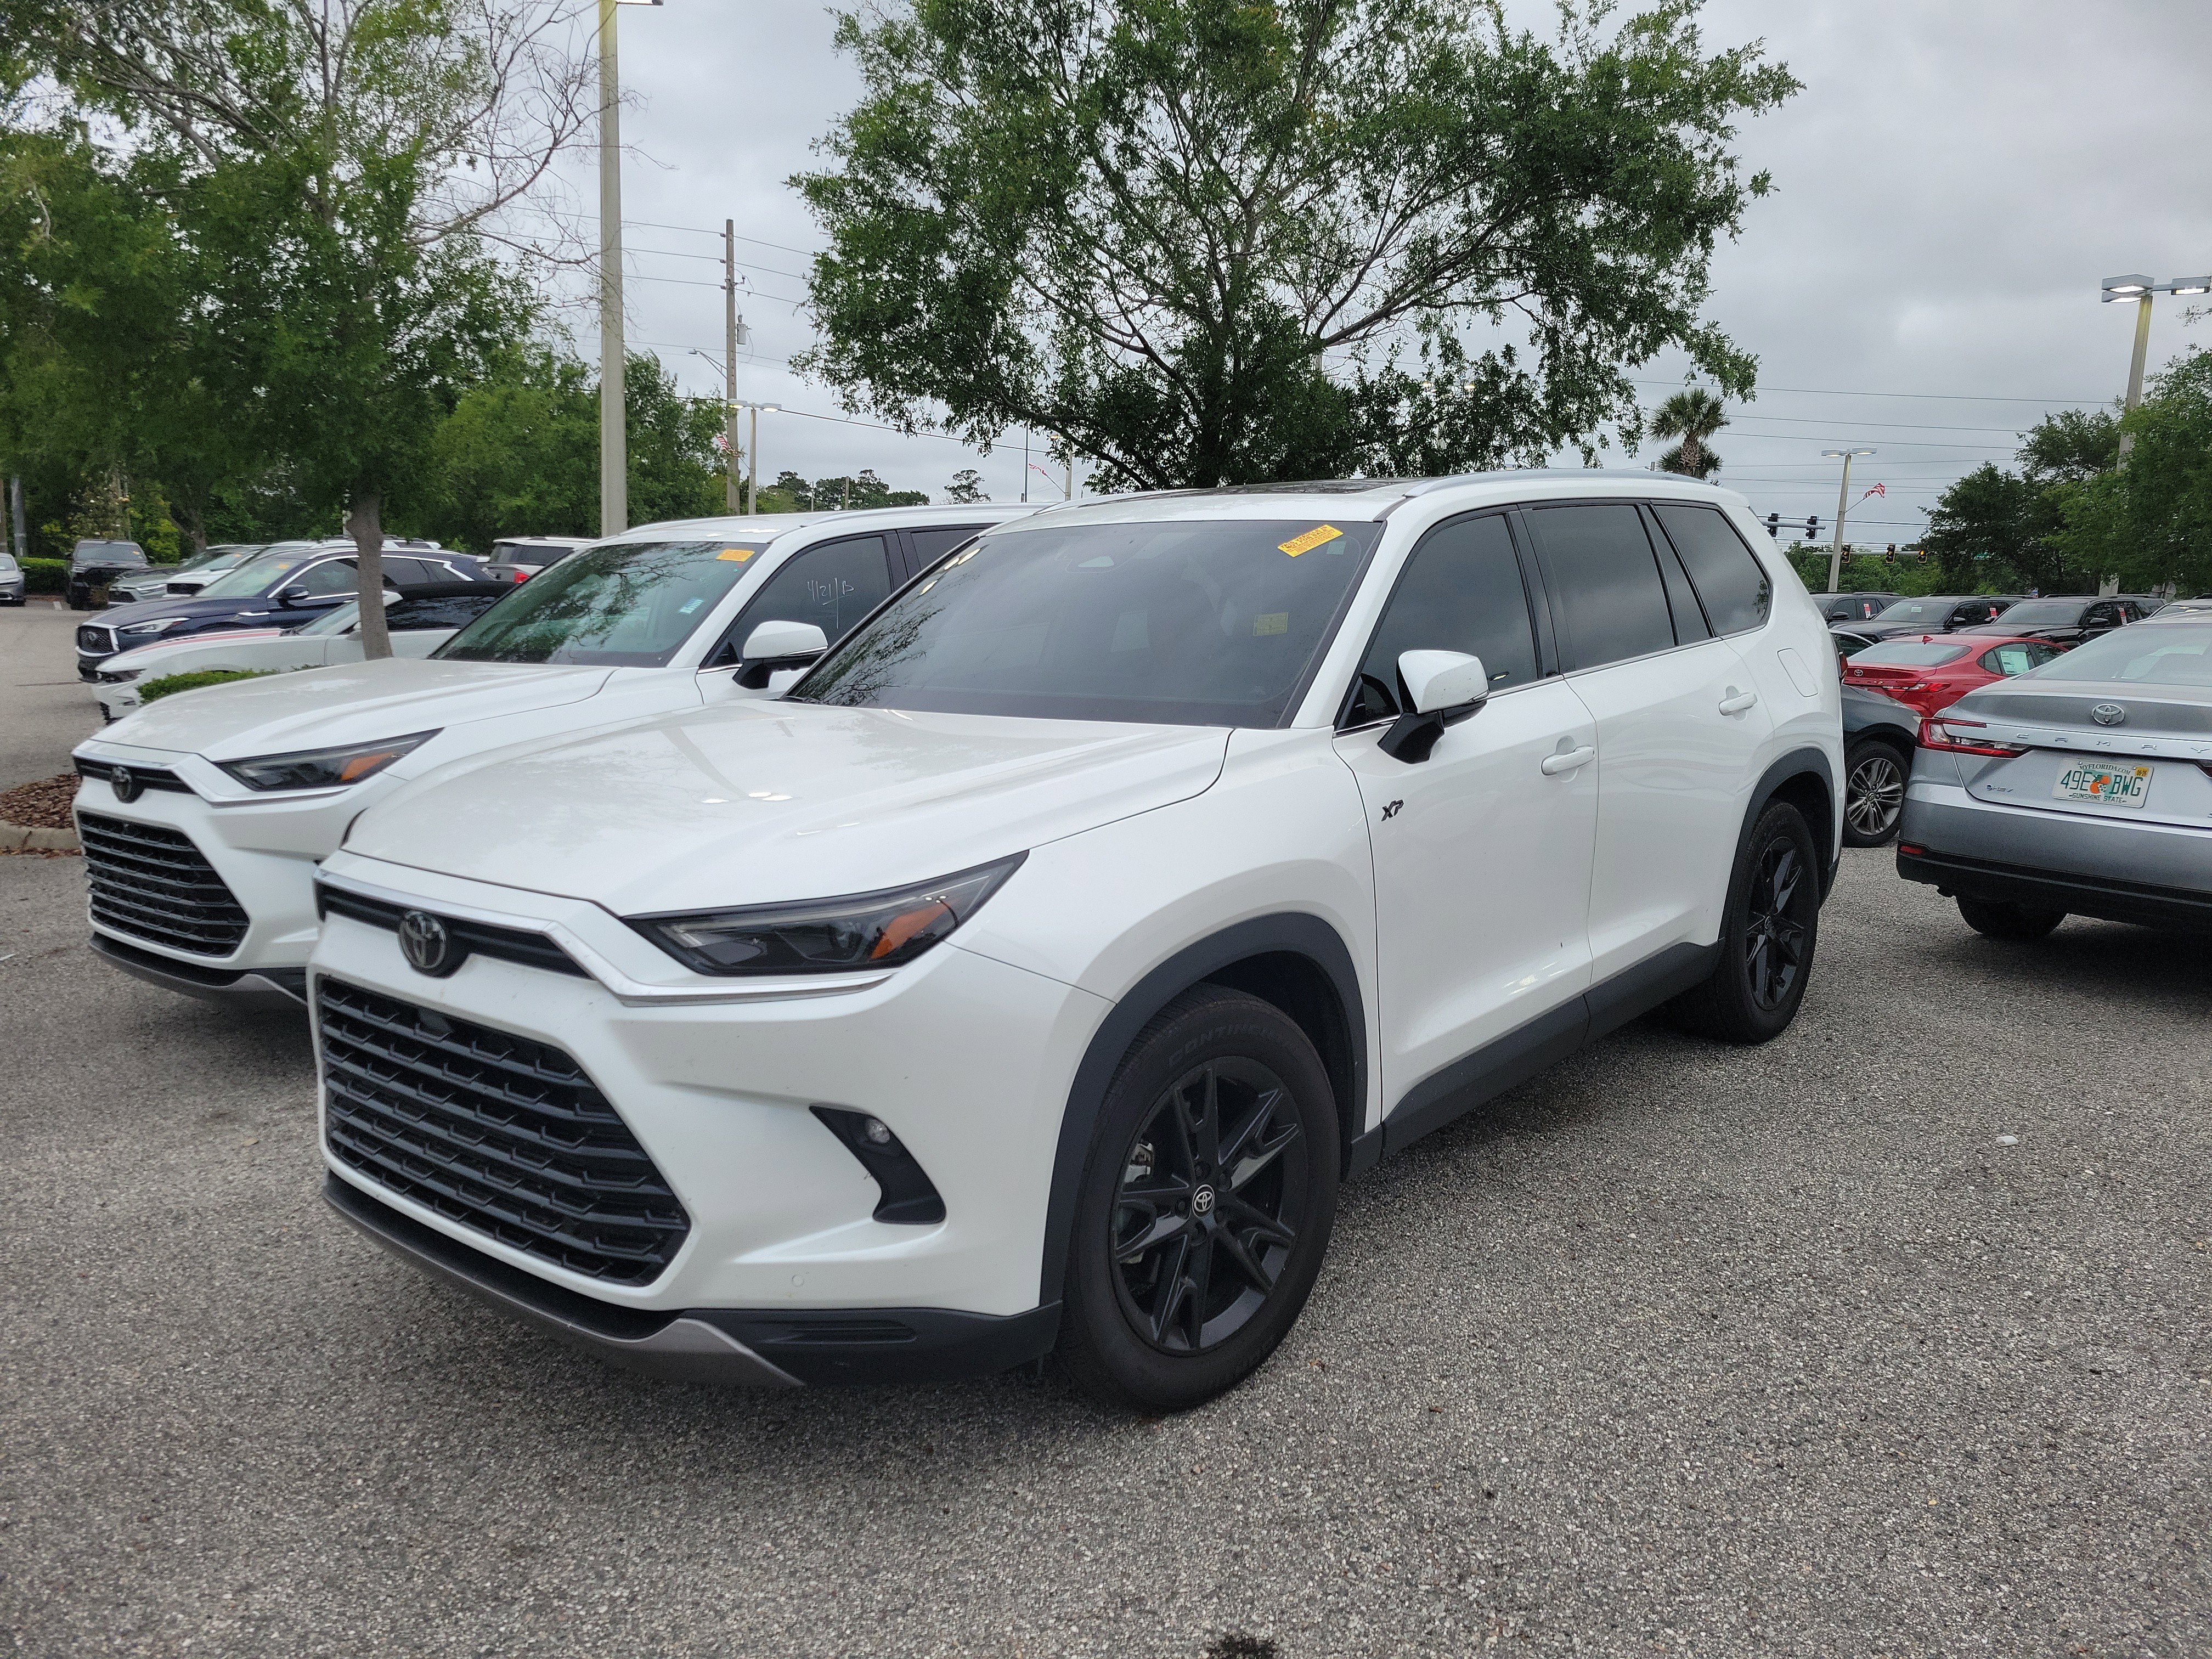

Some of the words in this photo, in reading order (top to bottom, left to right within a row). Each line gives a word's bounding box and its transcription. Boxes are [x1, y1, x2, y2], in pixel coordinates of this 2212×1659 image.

[2016, 732, 2211, 754] CAMRY
[2079, 763, 2131, 775] MYFLORIDA.COM
[2060, 770, 2093, 791] 49E
[2109, 774, 2143, 796] BWG
[2072, 792, 2102, 801] SUNSHINE
[2103, 795, 2123, 803] STATE
